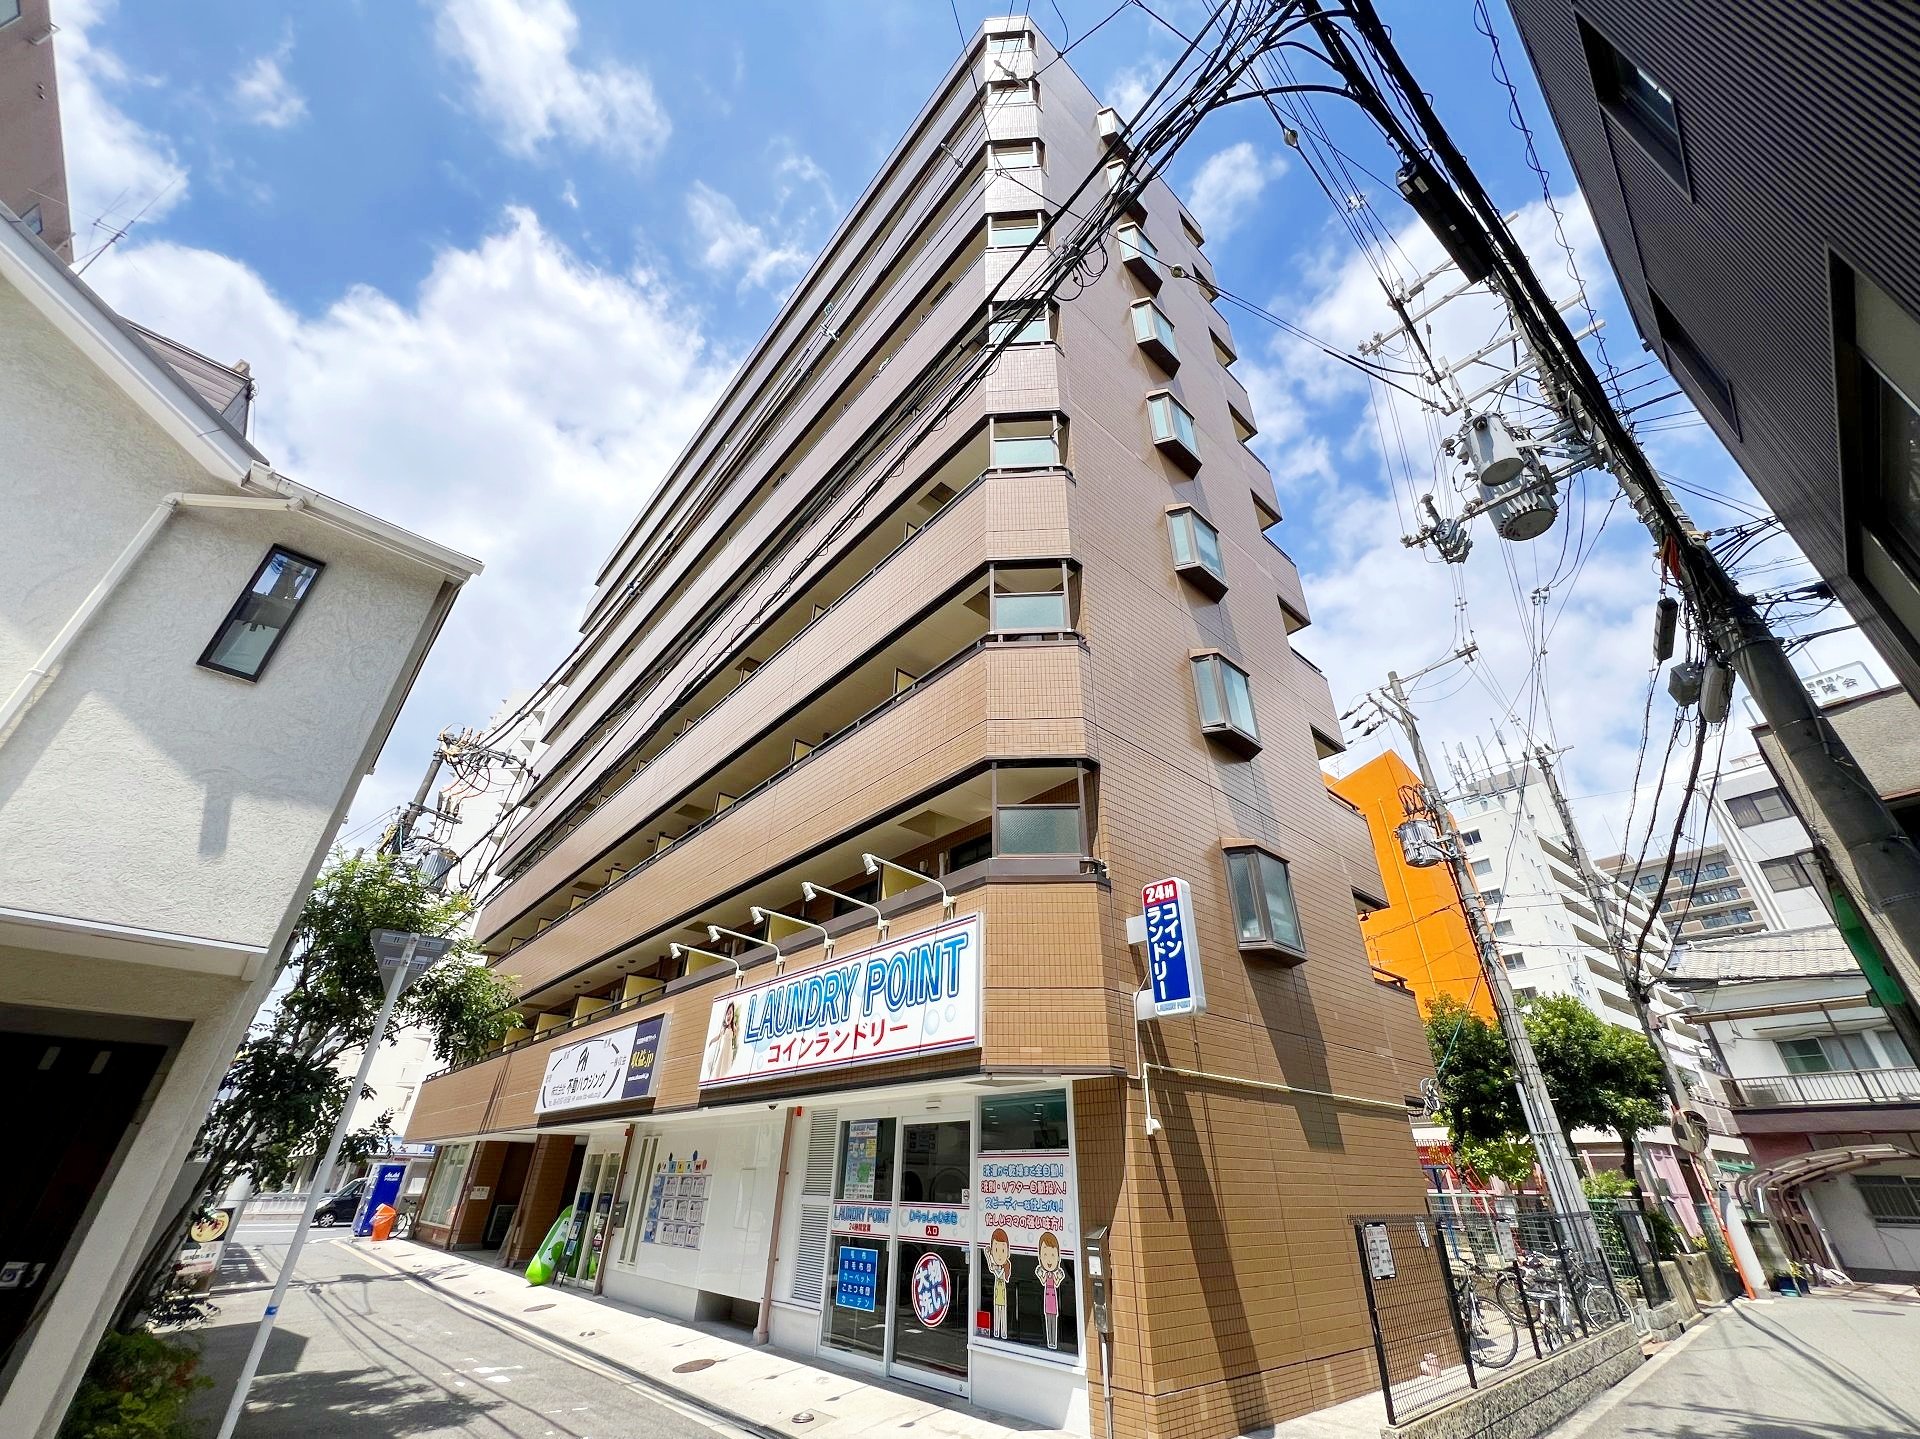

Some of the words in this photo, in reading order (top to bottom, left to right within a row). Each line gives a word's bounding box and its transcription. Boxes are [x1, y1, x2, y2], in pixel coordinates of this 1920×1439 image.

[1146, 883, 1175, 903] 24H
[1162, 903, 1182, 958] コイン
[1147, 906, 1167, 1000] ランドリー
[744, 962, 861, 1043] LAUNDRY
[863, 932, 968, 1017] POINT
[767, 1019, 908, 1063] コインランドリー
[834, 1205, 867, 1221] LAUNDRY
[867, 1207, 891, 1224] POINT
[927, 1226, 938, 1236] 入口
[843, 1273, 871, 1284] カーペット
[841, 1295, 870, 1308] カーテン
